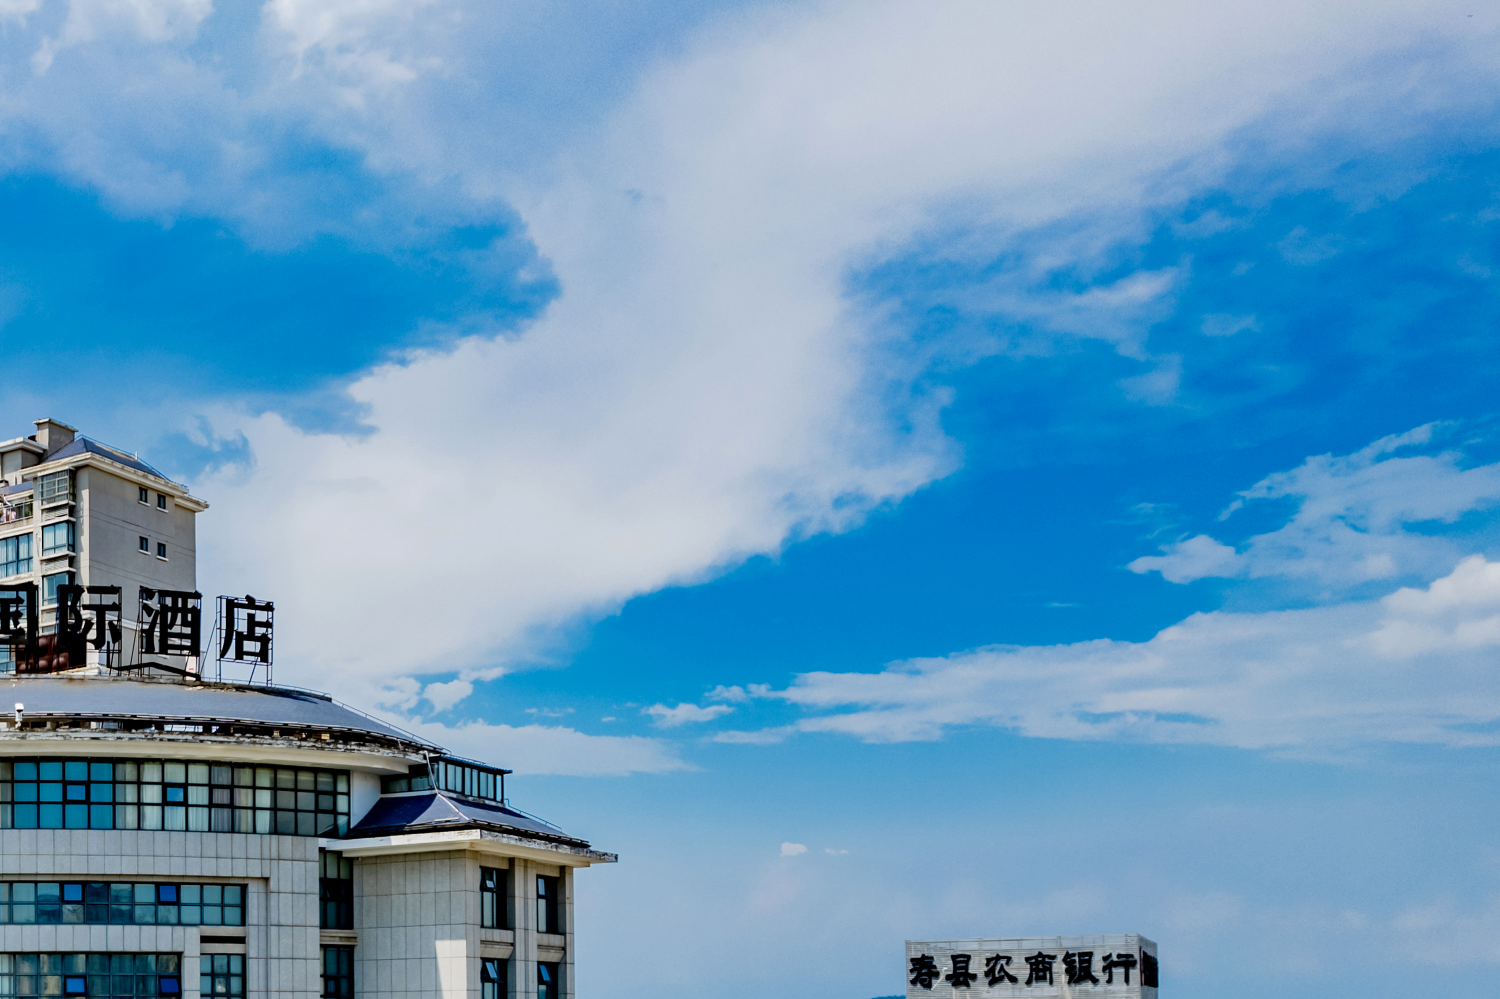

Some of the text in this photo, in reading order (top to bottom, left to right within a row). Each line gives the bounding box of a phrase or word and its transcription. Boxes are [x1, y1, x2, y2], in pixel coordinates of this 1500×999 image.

[909, 950, 1138, 989] 寿县农商银行
